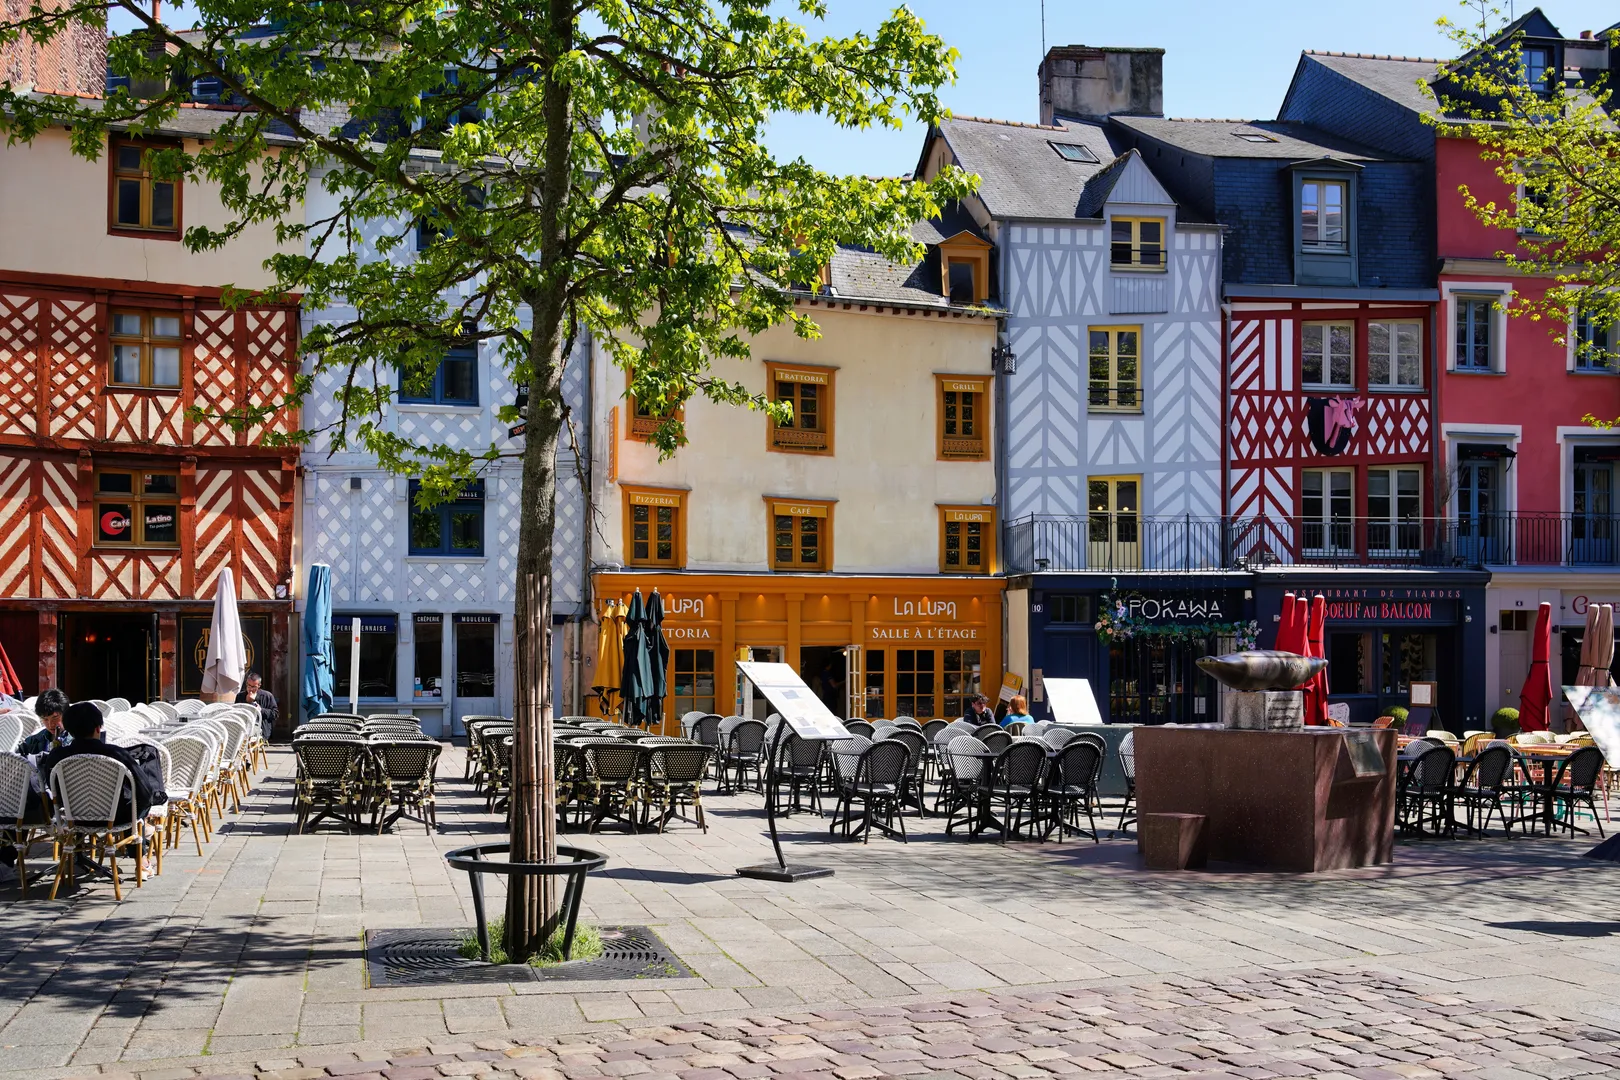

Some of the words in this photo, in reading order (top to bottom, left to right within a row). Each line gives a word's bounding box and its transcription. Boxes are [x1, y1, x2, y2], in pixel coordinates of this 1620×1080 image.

[779, 372, 824, 382] TRATTORIA
[636, 496, 674, 505] PIZZERIA
[790, 506, 811, 515] CAFÉ
[110, 518, 130, 528] Café
[145, 515, 172, 524] Latino
[1381, 590, 1394, 598] DE
[1407, 590, 1461, 598] VIANDES
[1033, 604, 1042, 612] 10
[1129, 599, 1223, 619] POKAWA
[1363, 606, 1378, 619] AU
[1381, 603, 1432, 619] BALCON
[417, 615, 440, 623] CRÊPERIE
[662, 628, 710, 638] TORIA
[872, 627, 910, 639] SALLE
[914, 626, 922, 639] À
[927, 627, 977, 639] L'ÉTAGE
